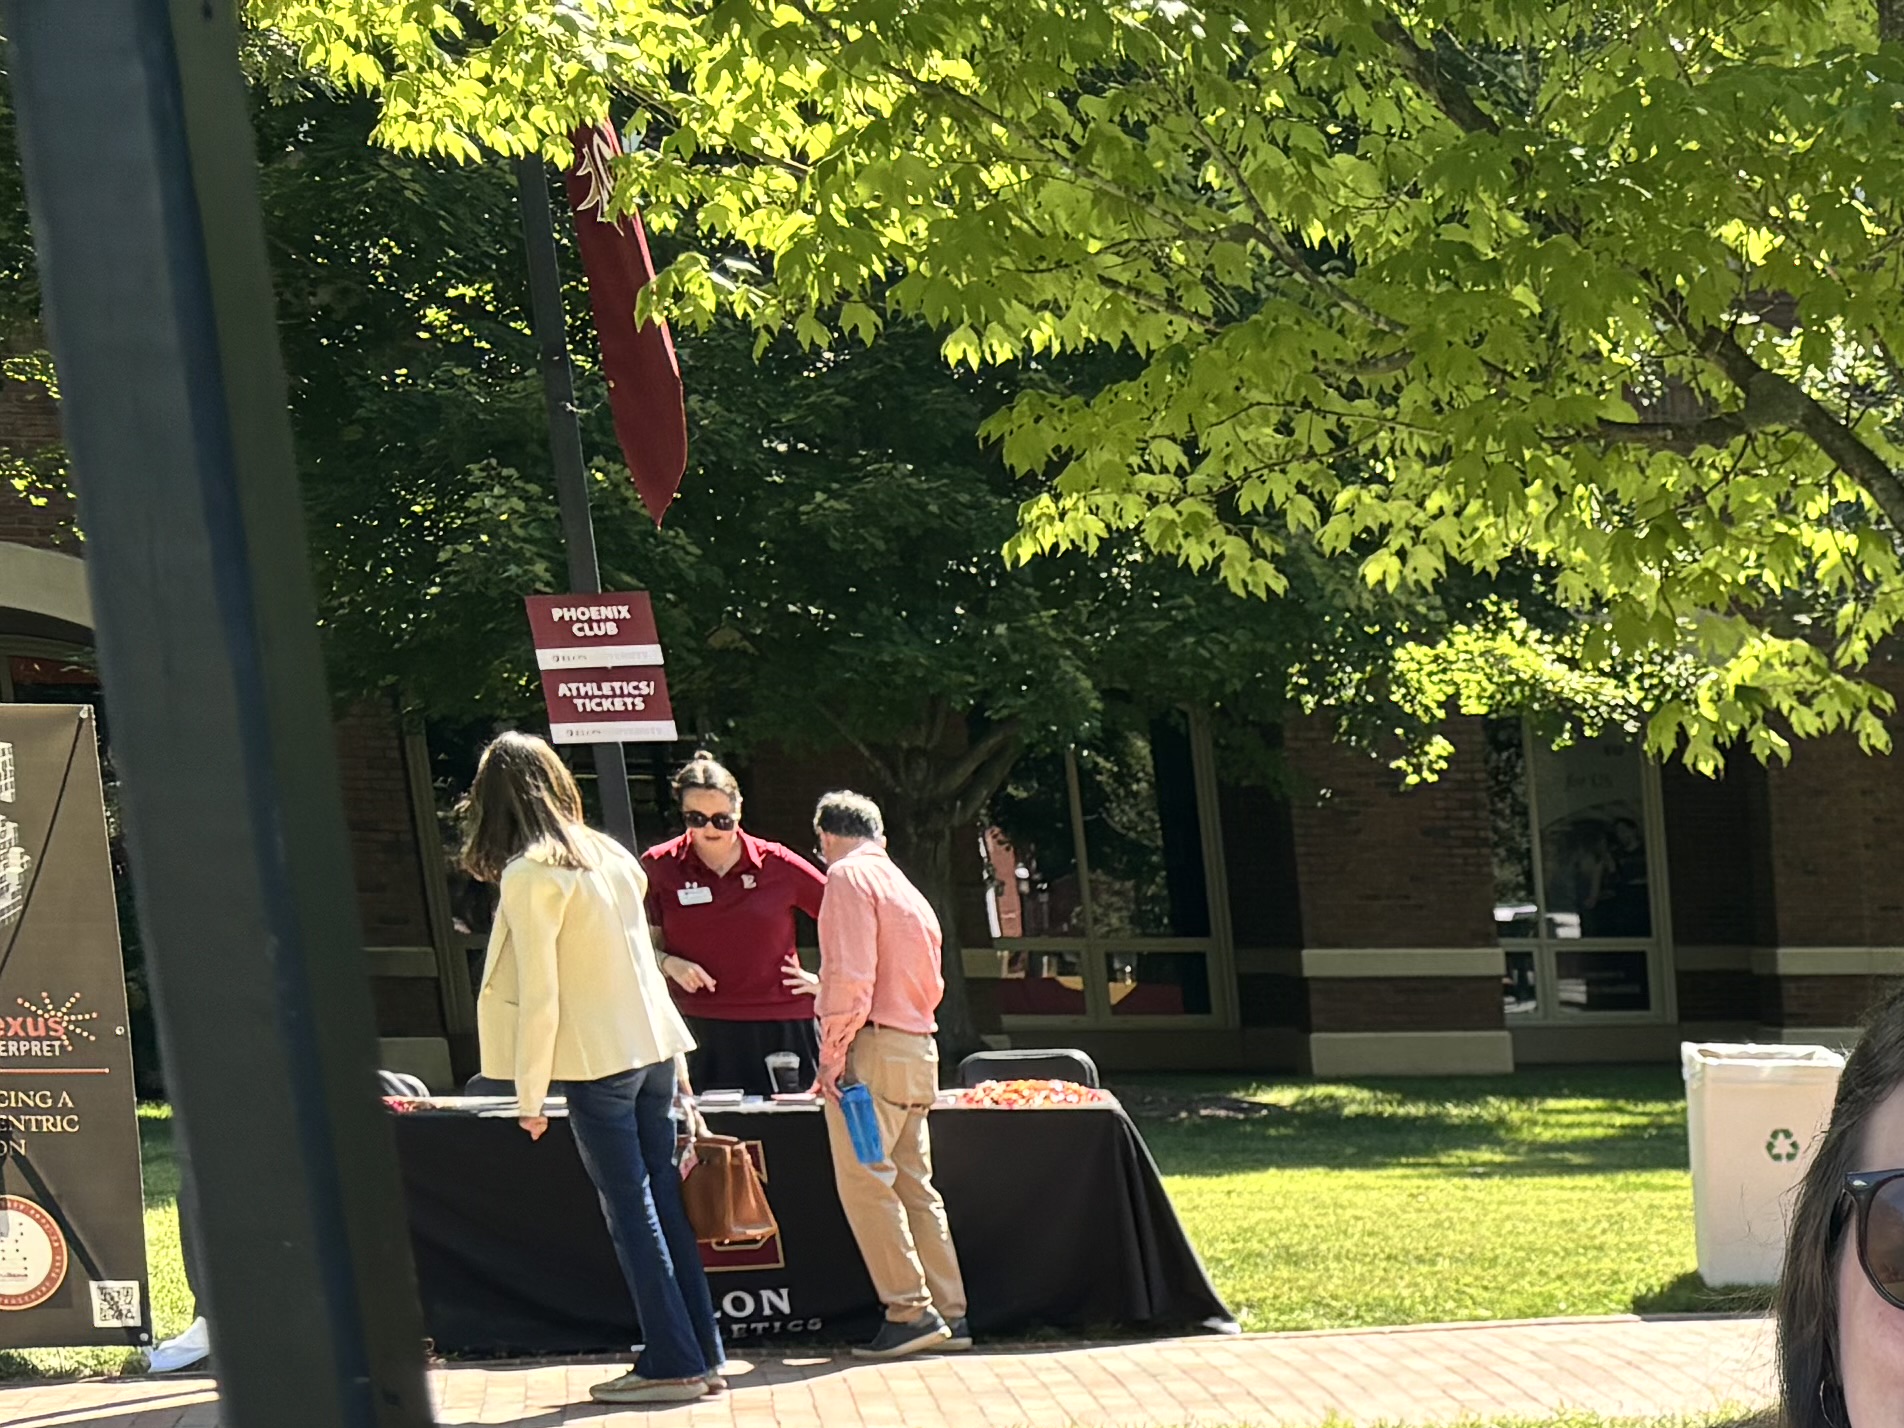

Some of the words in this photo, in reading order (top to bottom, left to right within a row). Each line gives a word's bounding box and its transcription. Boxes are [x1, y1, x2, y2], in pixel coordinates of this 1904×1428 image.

[551, 605, 631, 622] PHOENIX
[572, 621, 618, 637] CLUB
[558, 681, 655, 697] ATHLETICS/
[573, 697, 645, 712] TICKETS
[57, 1091, 74, 1108] A
